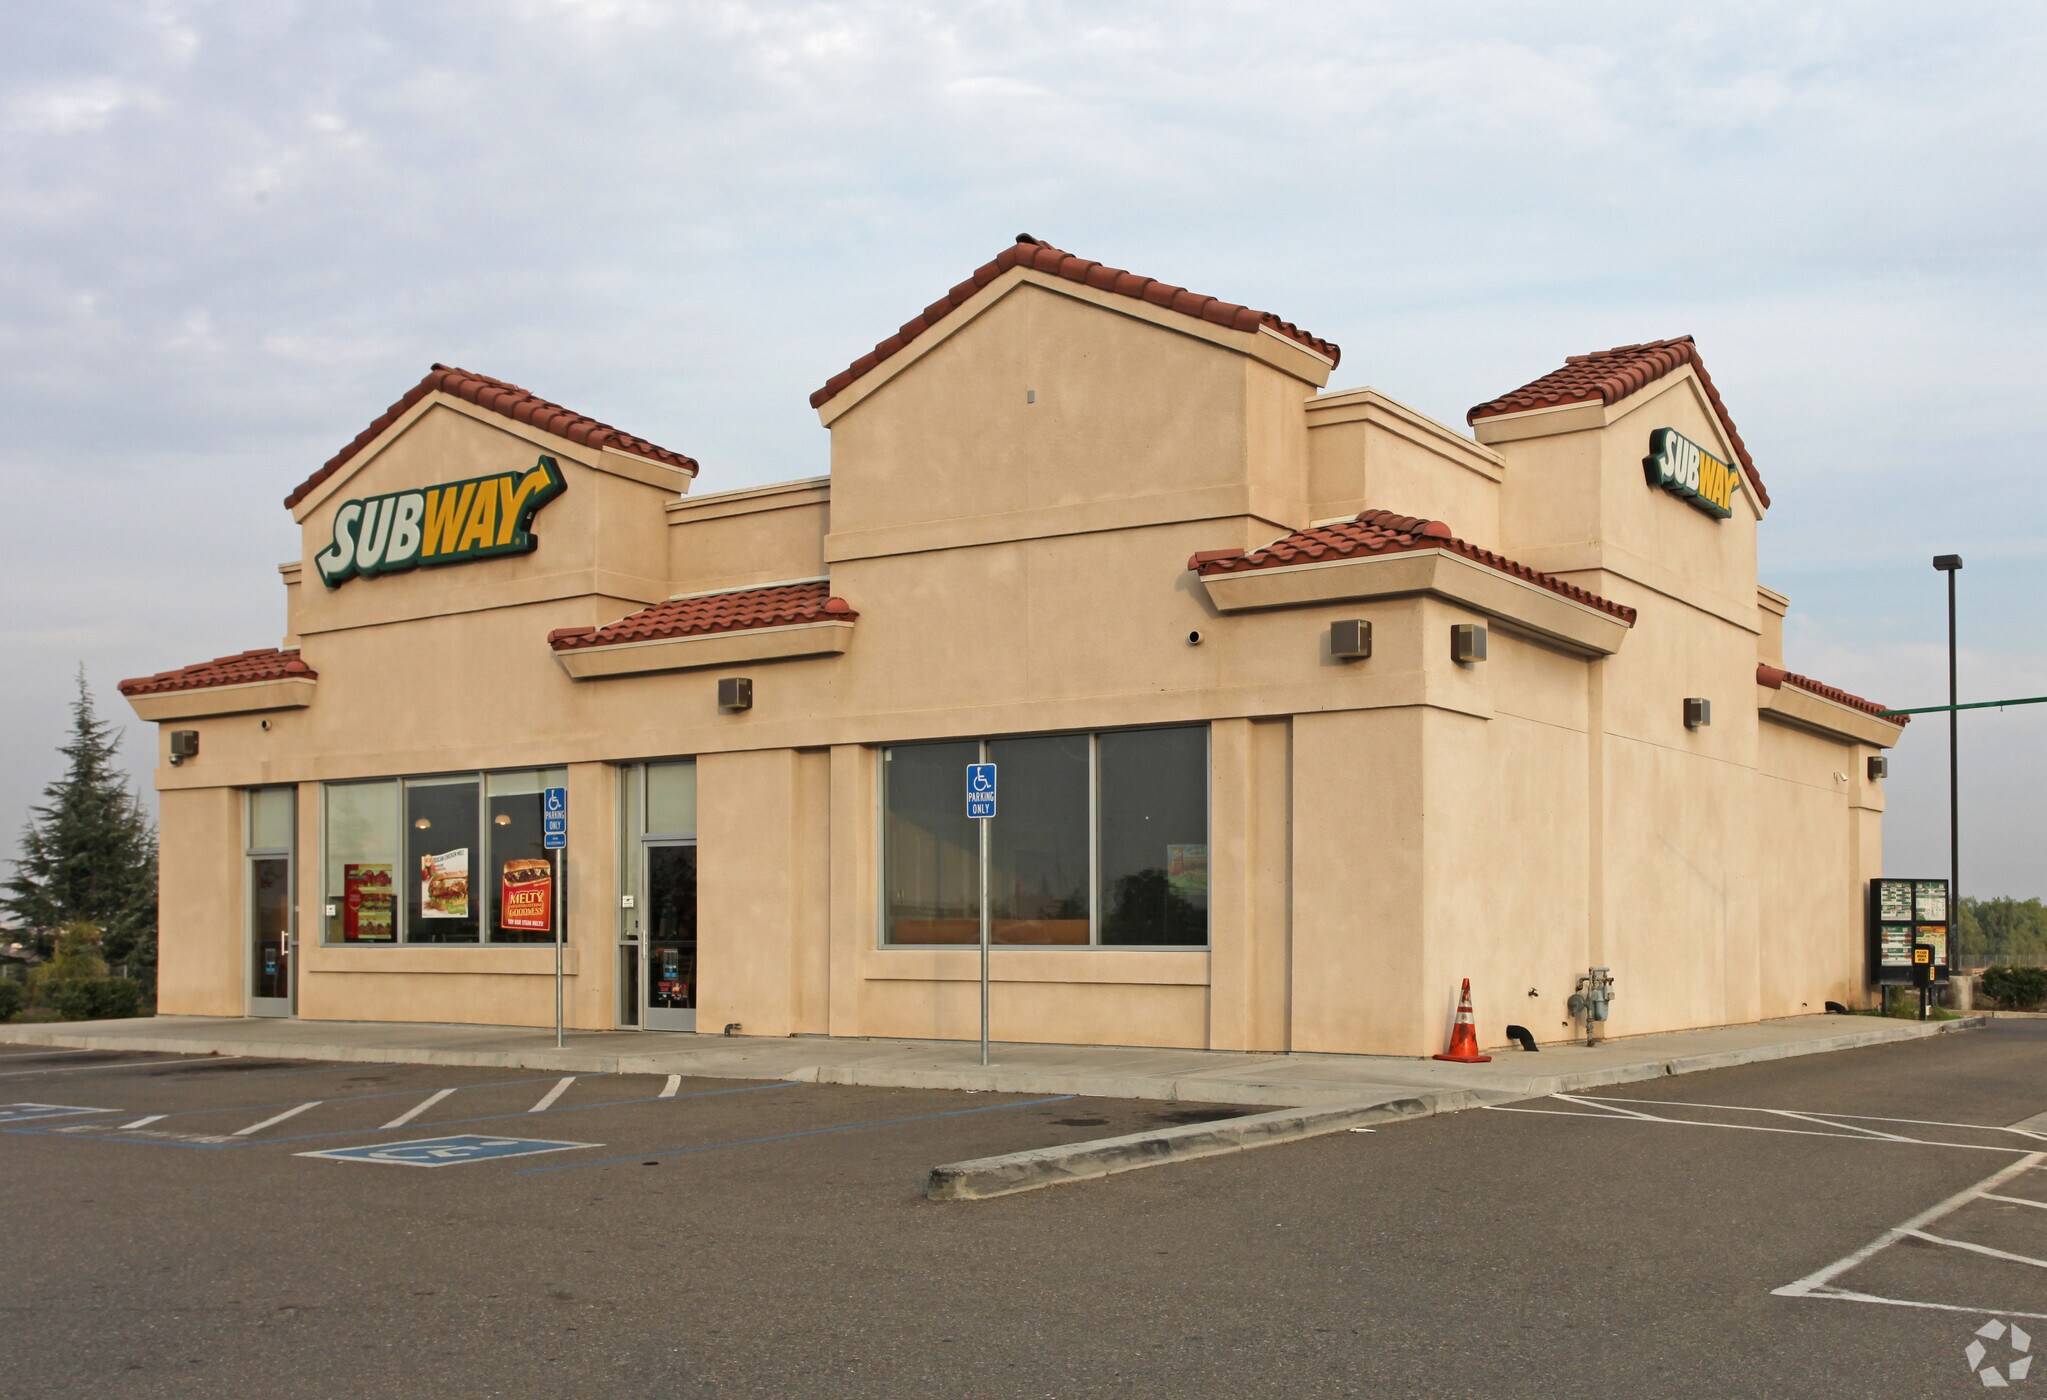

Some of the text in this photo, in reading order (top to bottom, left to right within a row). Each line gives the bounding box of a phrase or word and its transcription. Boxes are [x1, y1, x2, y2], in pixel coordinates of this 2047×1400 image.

[1658, 430, 1740, 511] SUBWAY
[317, 463, 552, 579] SUBWAY
[969, 792, 994, 802] PARKING
[973, 804, 990, 814] ONLY
[546, 811, 565, 820] PARKING
[550, 821, 561, 830] ONLY
[510, 892, 543, 904] MELTY
[509, 907, 543, 915] GOODNESS
